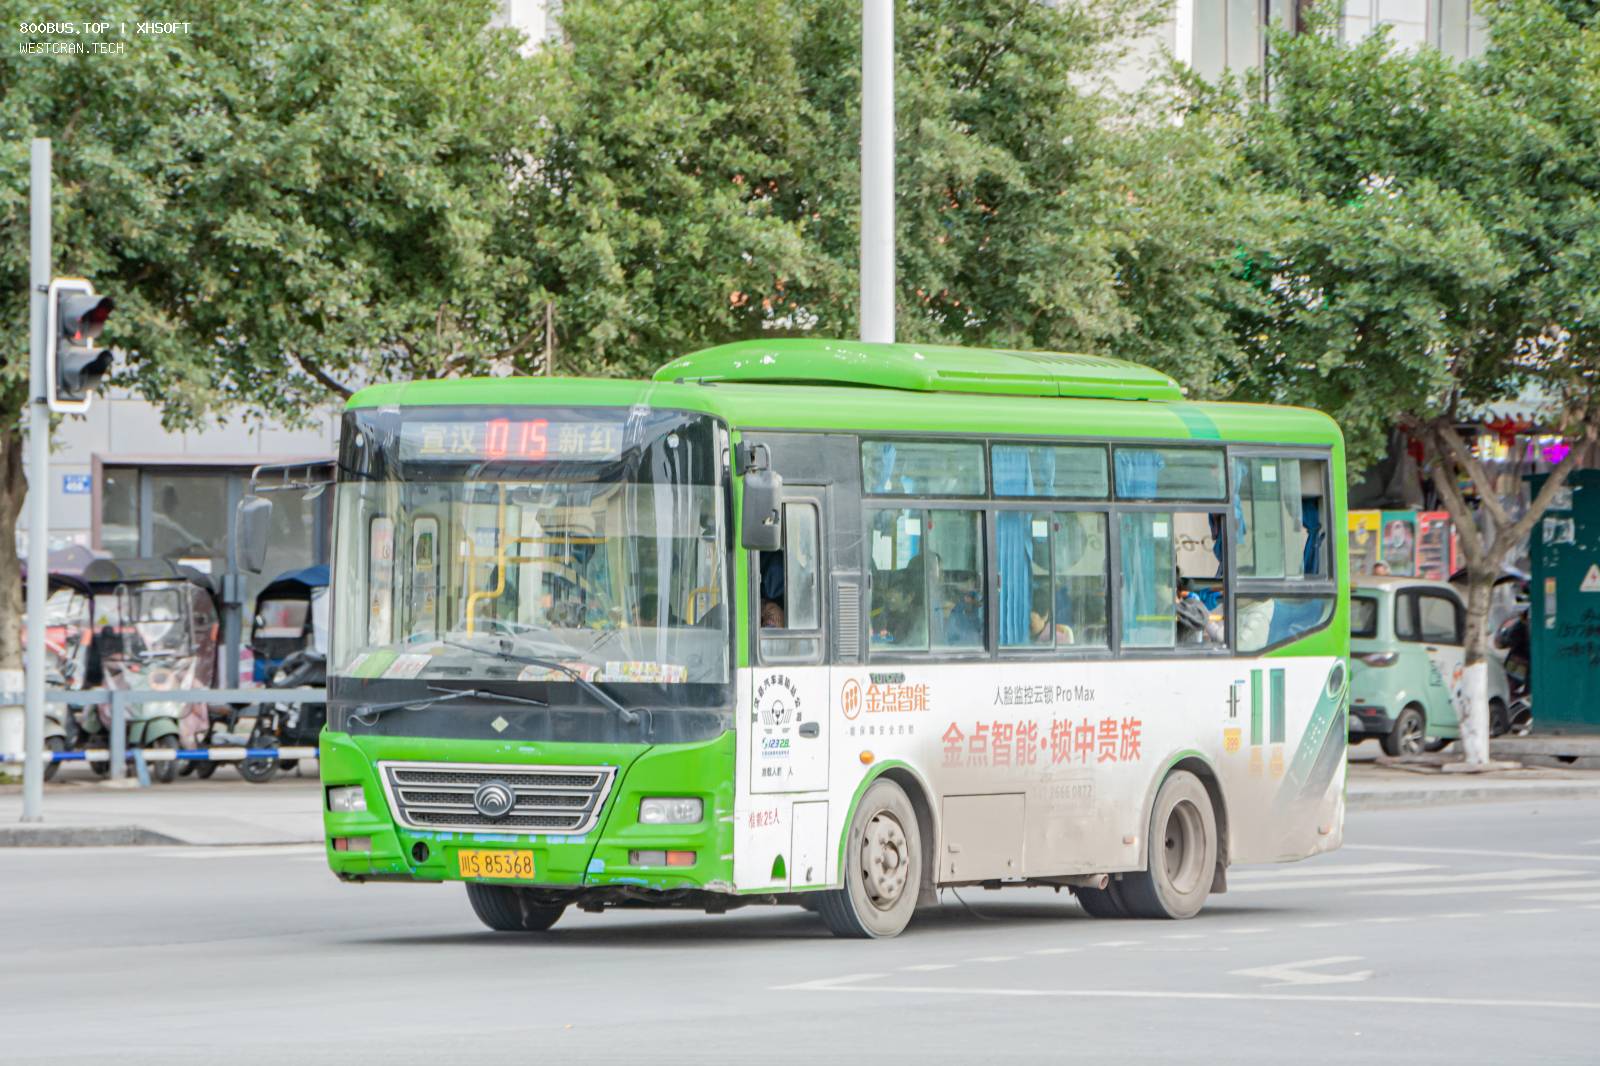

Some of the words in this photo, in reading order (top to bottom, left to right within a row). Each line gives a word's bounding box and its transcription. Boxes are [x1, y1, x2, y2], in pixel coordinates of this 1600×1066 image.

[420, 424, 476, 454] 宣汉
[486, 418, 548, 459] 015
[559, 425, 616, 454] 新红
[865, 683, 931, 713] 金点智能
[993, 685, 1054, 705] 人脸监控云锁
[1055, 685, 1073, 702] Pro
[1074, 685, 1095, 702] Max
[461, 855, 480, 873] 川S
[484, 855, 532, 874] 85368
